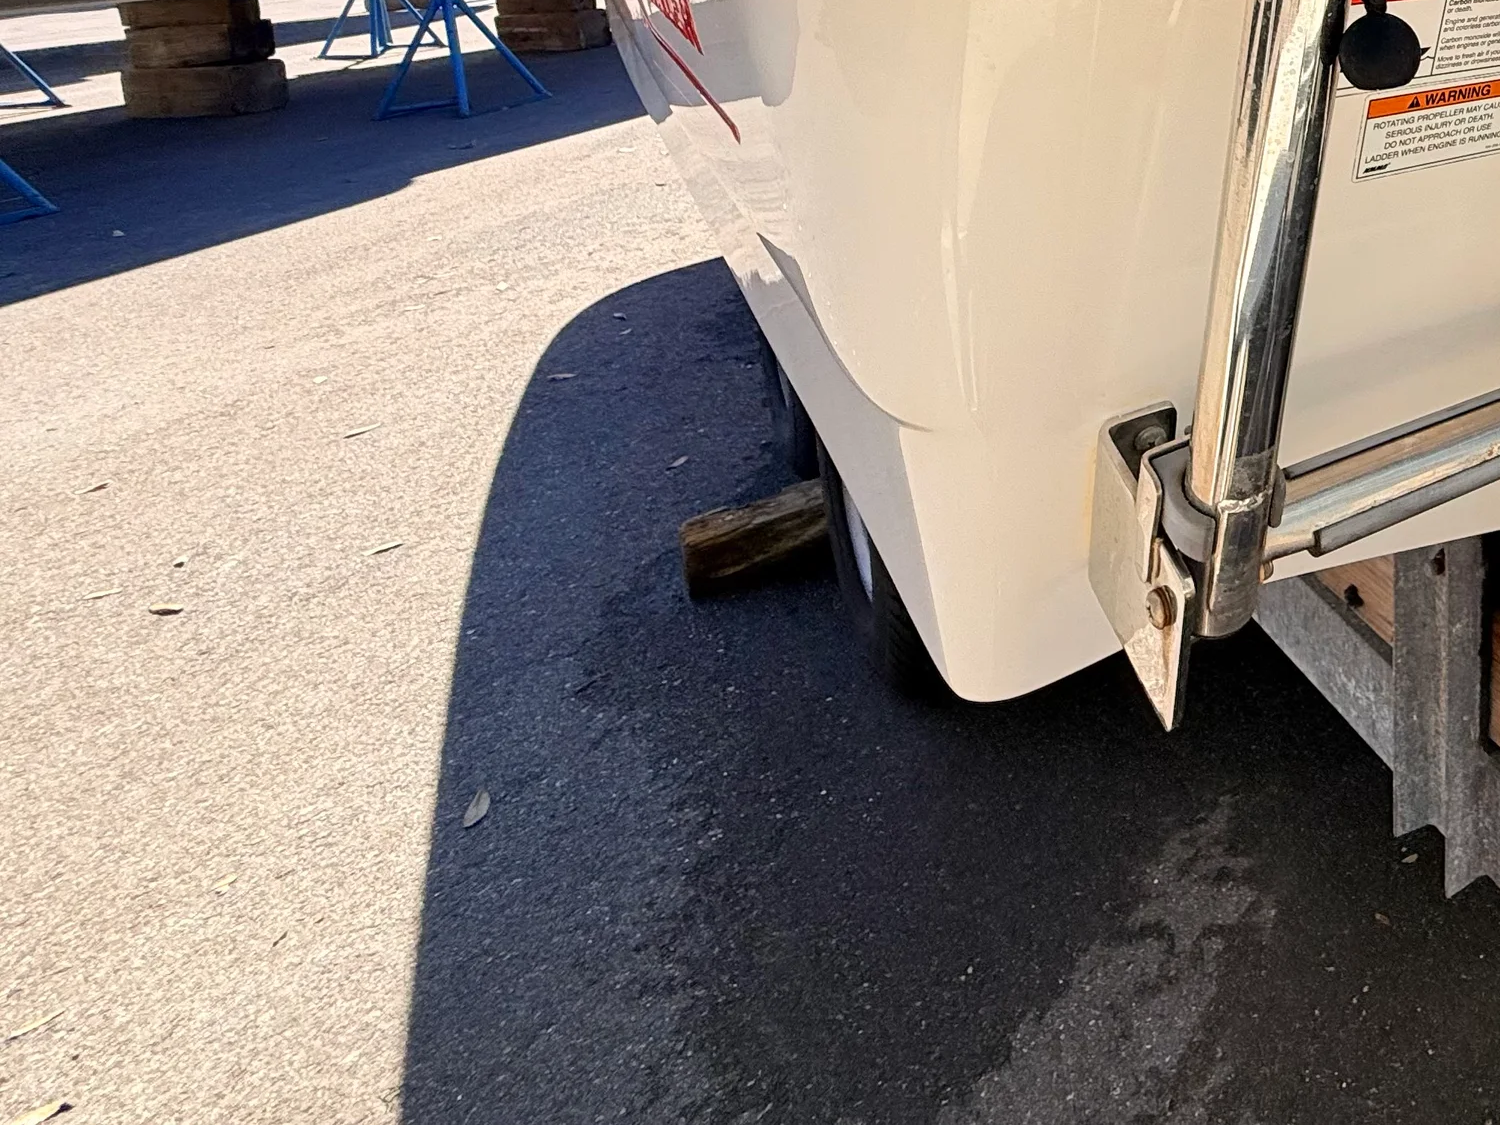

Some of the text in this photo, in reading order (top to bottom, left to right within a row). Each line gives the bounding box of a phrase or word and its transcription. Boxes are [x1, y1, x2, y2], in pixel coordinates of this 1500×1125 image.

[1425, 84, 1491, 106] WARNING
[1373, 116, 1415, 130] ROTATING
[1417, 108, 1464, 122] PROPELLER
[1466, 104, 1483, 114] MAY
[1385, 113, 1494, 139] SERIOUS INJURY OR DEATH.
[1384, 122, 1492, 150] DO NOT APPROACH OR USE
[1365, 150, 1399, 164] LADDER
[1401, 146, 1426, 156] WHEN
[1428, 139, 1457, 151] ENGINE
[1459, 137, 1466, 145] IS
